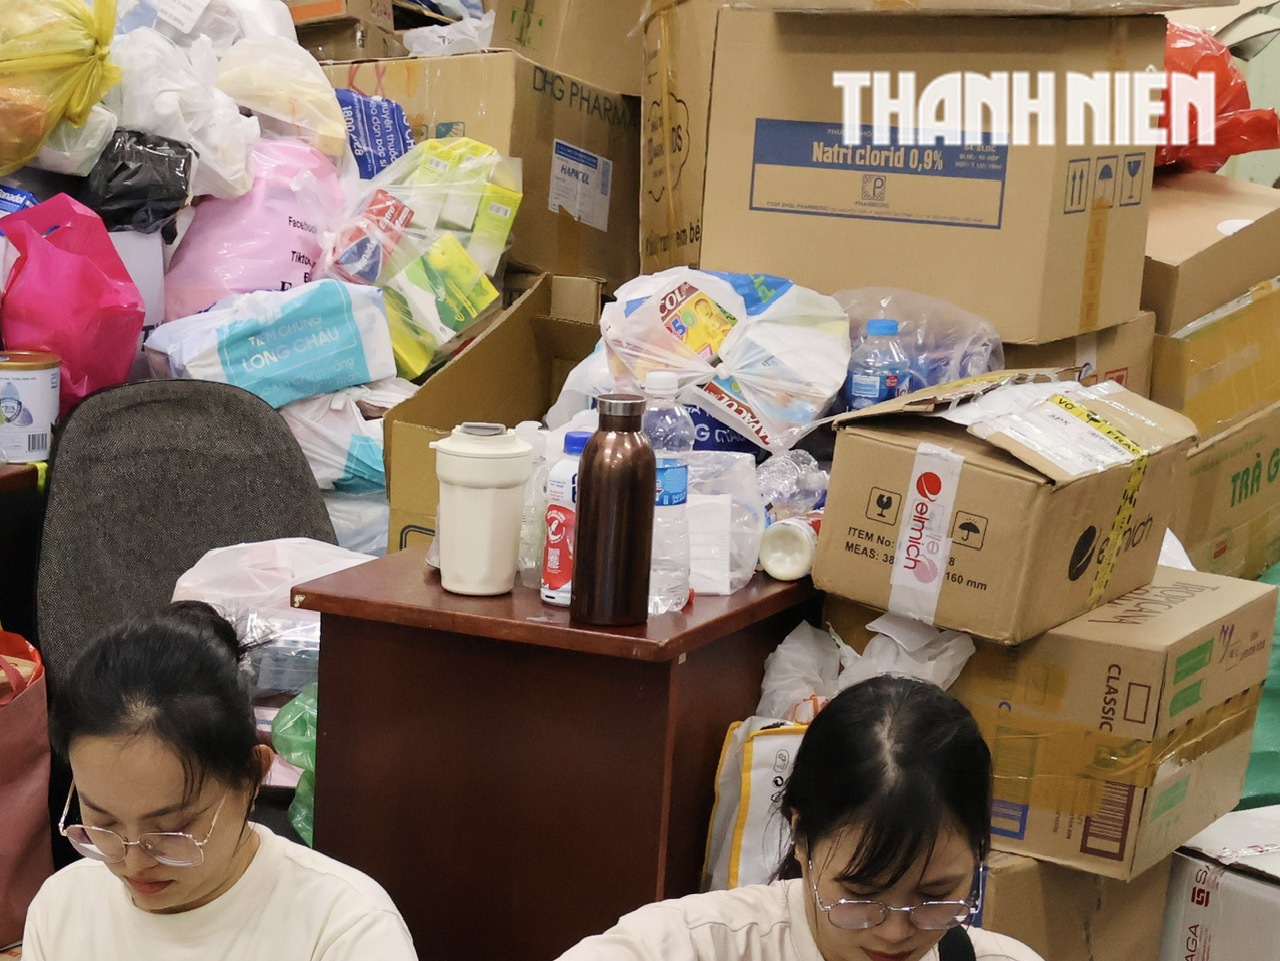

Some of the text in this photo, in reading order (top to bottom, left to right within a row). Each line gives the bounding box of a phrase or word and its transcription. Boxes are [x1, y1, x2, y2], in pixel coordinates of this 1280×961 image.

[532, 65, 565, 101] DHG
[811, 141, 945, 171] Natri clorid 0,9%
[1230, 452, 1263, 507] TRÀ
[844, 541, 880, 562] MEAS:
[848, 525, 895, 549] ITEM No:
[903, 501, 930, 571] elmich
[966, 578, 988, 592] mm
[1099, 663, 1122, 733] CLASSIC
